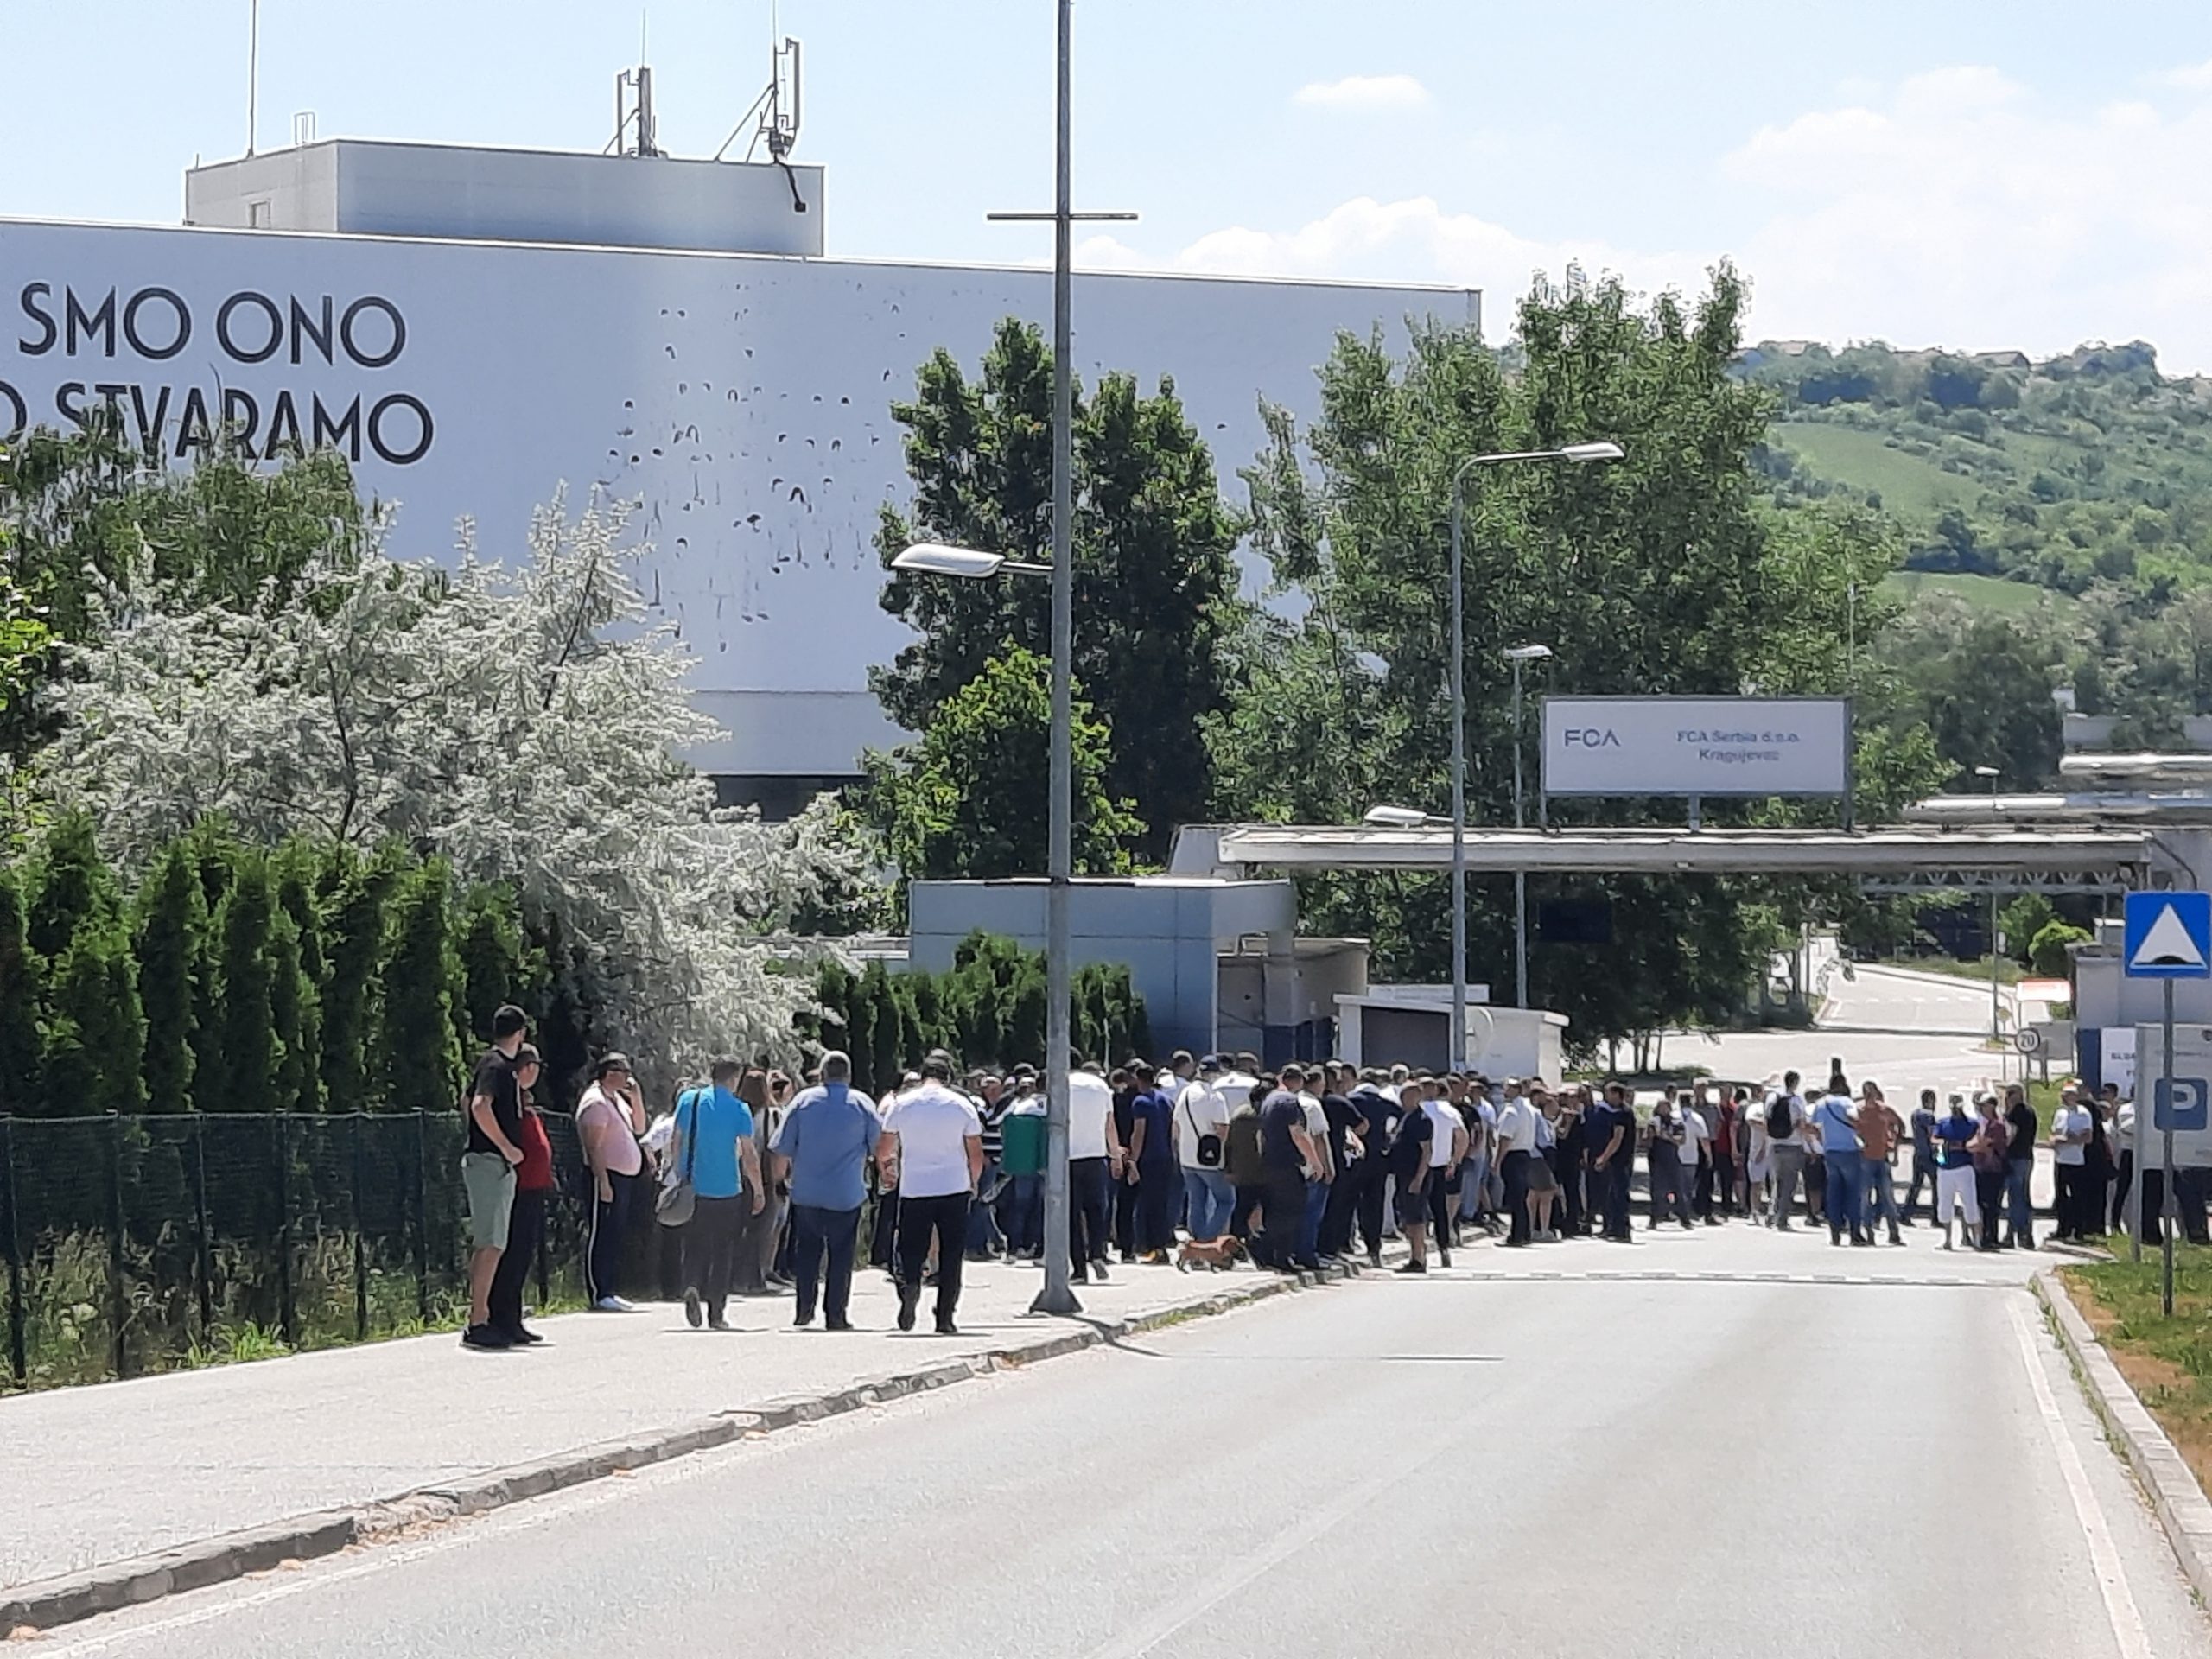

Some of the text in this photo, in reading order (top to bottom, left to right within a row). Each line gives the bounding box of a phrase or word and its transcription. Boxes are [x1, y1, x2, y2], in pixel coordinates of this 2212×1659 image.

[19, 283, 406, 367] SMO ONO
[56, 382, 433, 467] STVARAMO
[1563, 728, 1621, 748] FCA
[1676, 730, 1708, 743] FCA
[1712, 730, 1757, 743] Serbia
